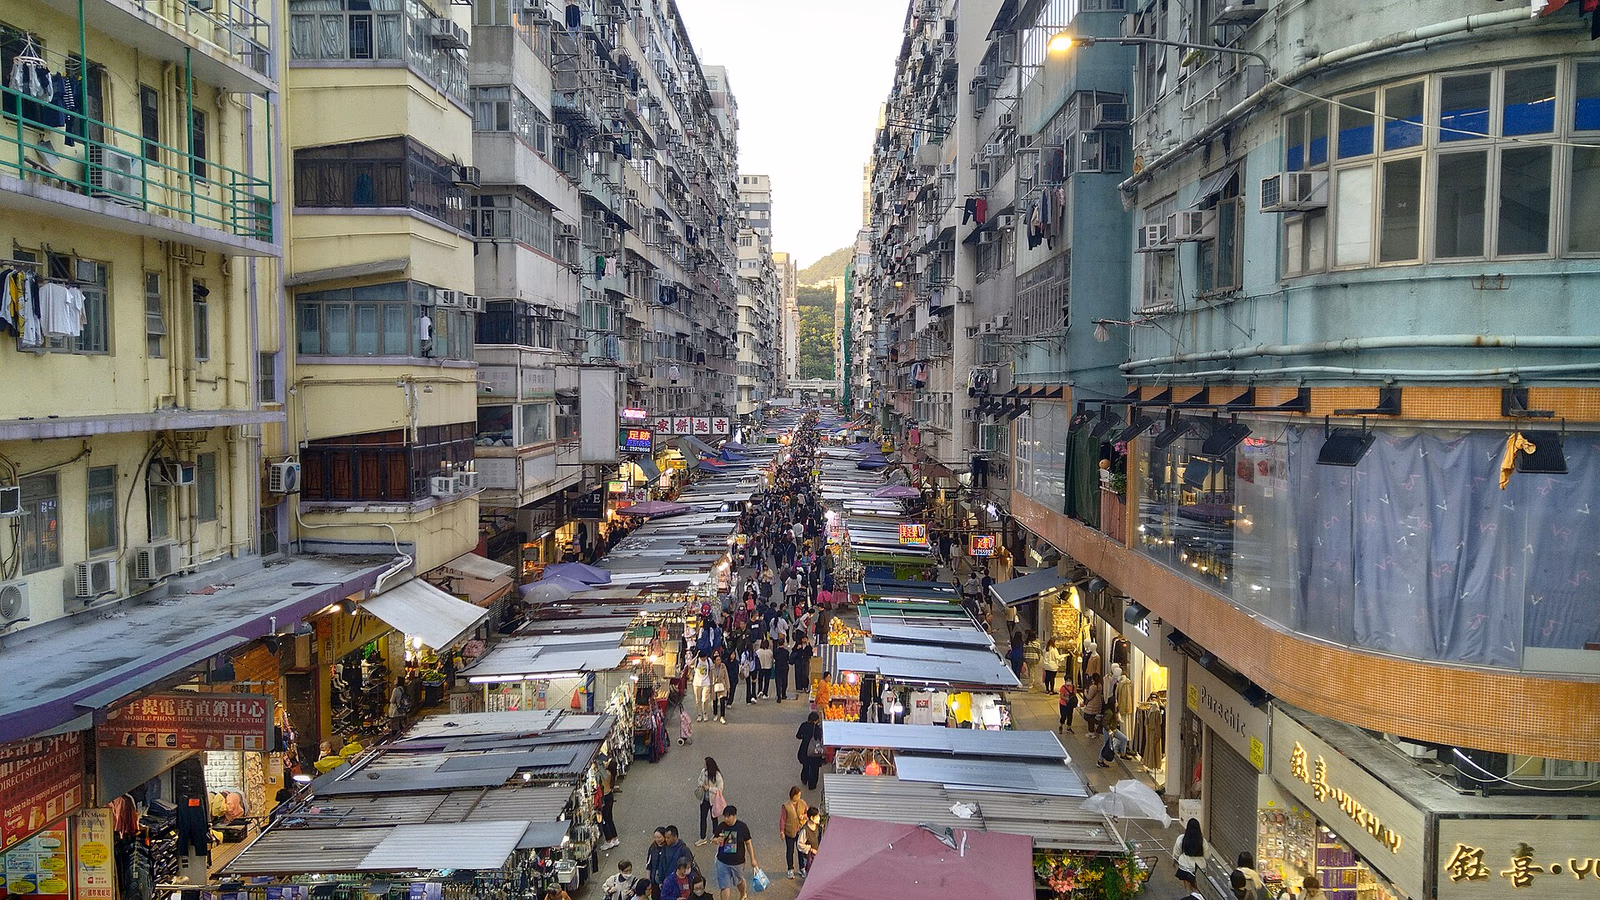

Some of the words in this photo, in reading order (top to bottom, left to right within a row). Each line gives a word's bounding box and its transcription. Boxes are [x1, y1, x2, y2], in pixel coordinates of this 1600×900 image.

[126, 698, 264, 718] 手提電話直銷中心
[1201, 686, 1246, 738] Purechic
[26, 758, 55, 778] SELLING
[56, 744, 80, 764] CENTRE
[12, 804, 20, 814] shop
[1366, 812, 1401, 854] HAY
